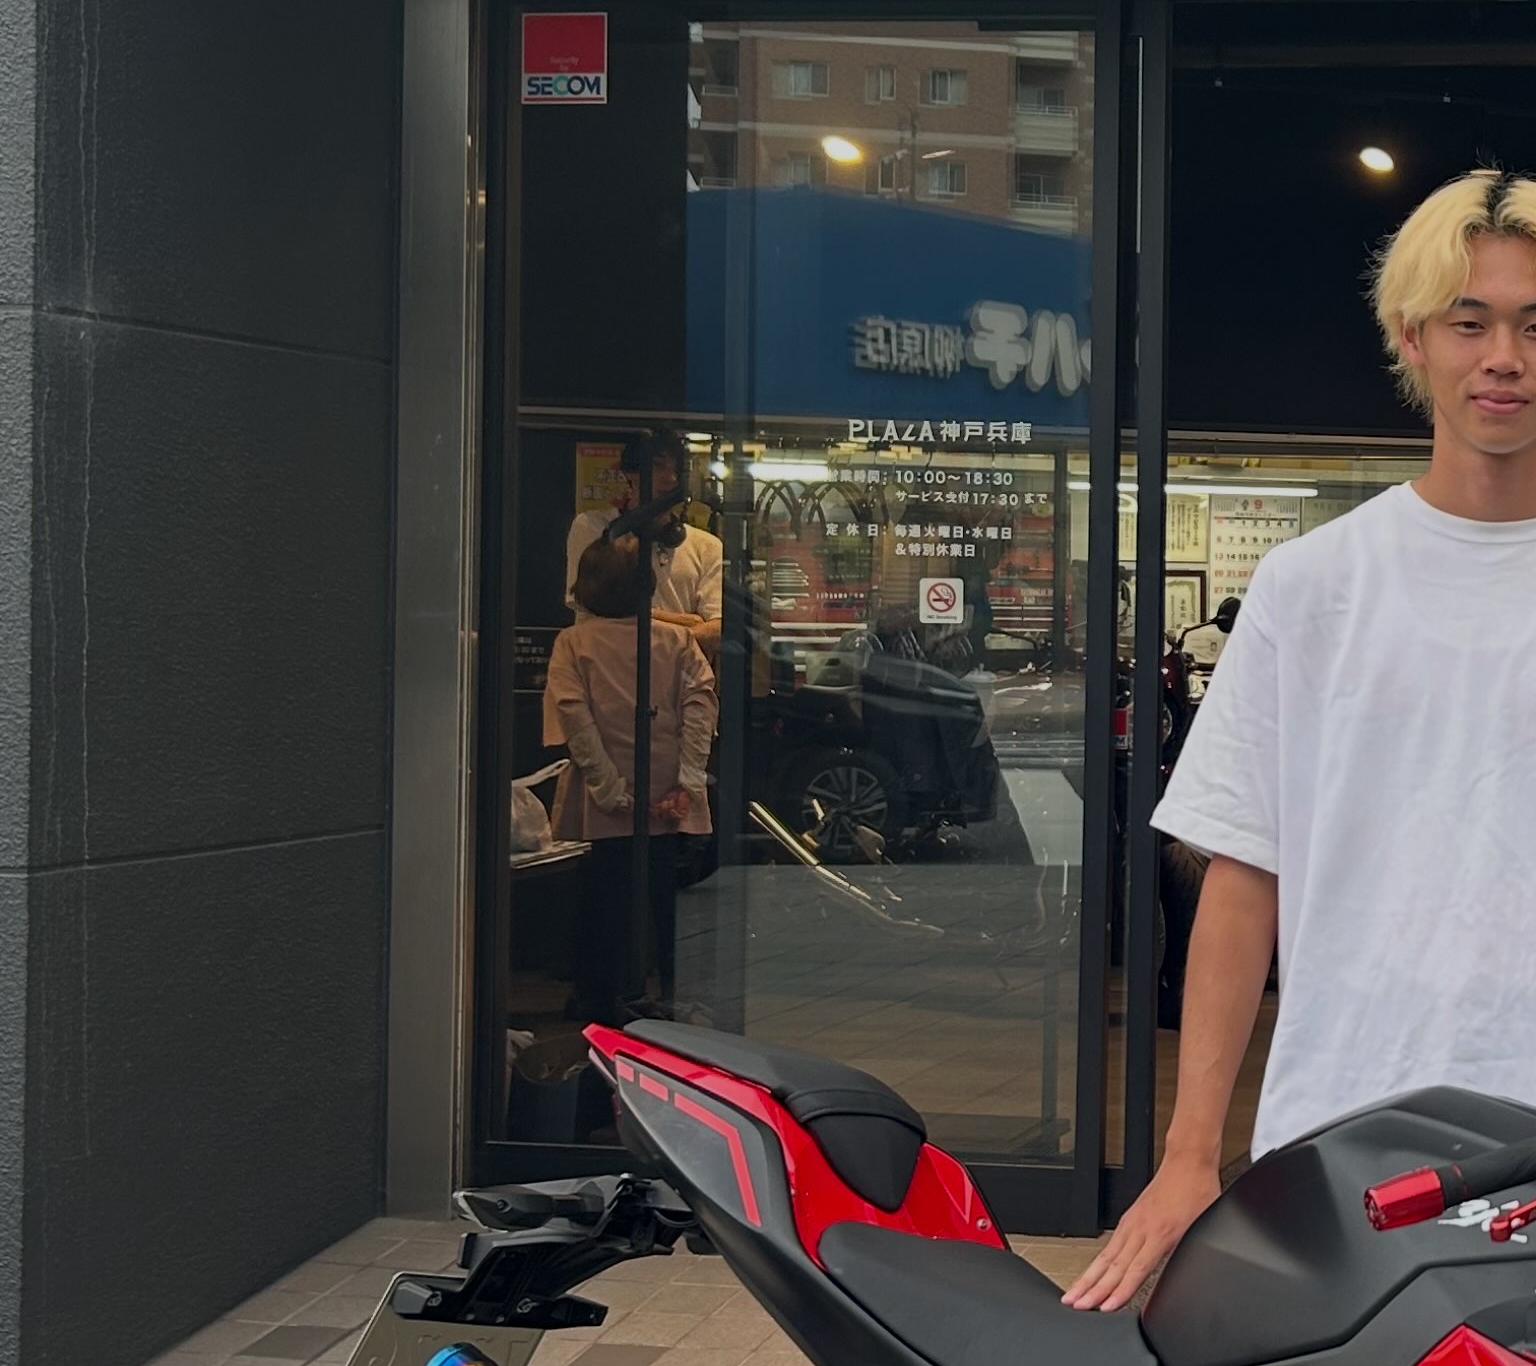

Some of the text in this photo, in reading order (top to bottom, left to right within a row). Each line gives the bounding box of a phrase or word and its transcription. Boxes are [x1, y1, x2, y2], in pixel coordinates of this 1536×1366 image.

[527, 76, 601, 95] SECOM
[847, 419, 1032, 445] PLAZA 神戸兵庫
